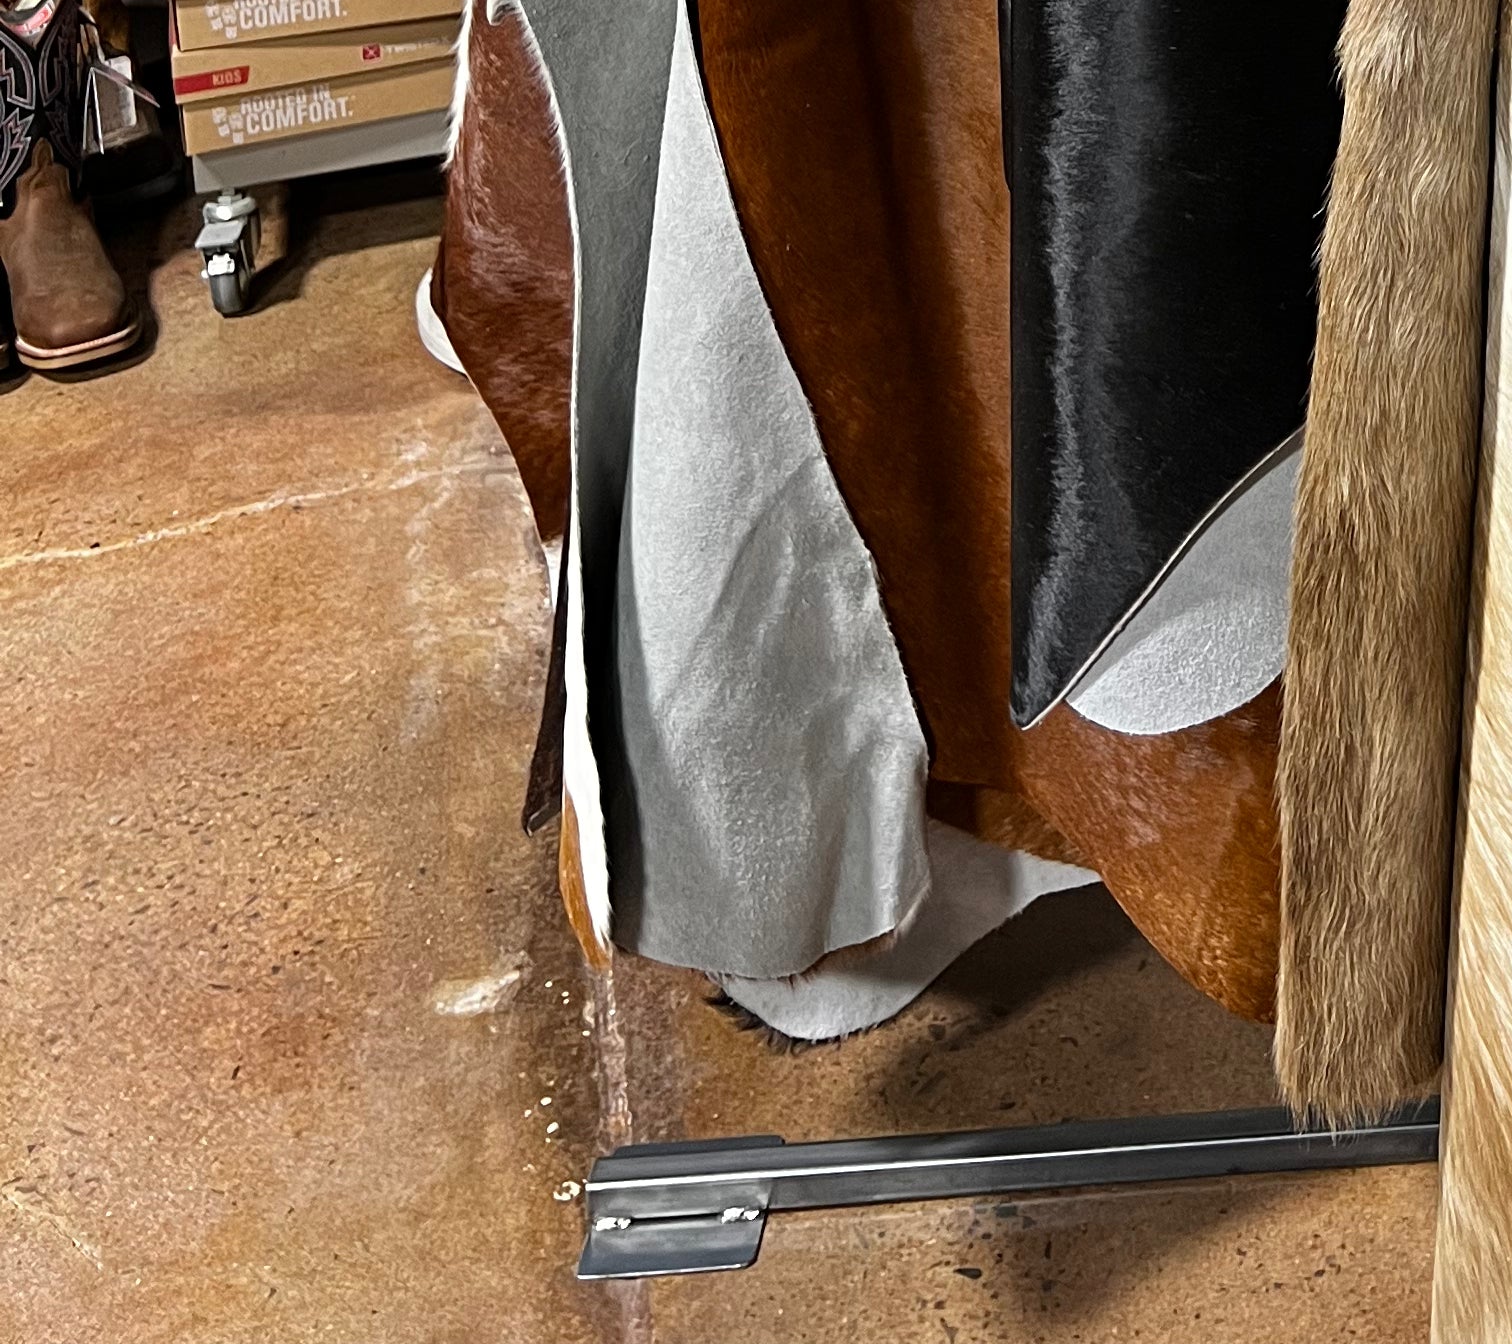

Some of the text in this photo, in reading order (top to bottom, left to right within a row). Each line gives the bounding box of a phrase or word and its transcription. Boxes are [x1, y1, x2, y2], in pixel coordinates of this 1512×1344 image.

[212, 69, 242, 87] KIDS
[239, 83, 331, 114] ROOTED IN
